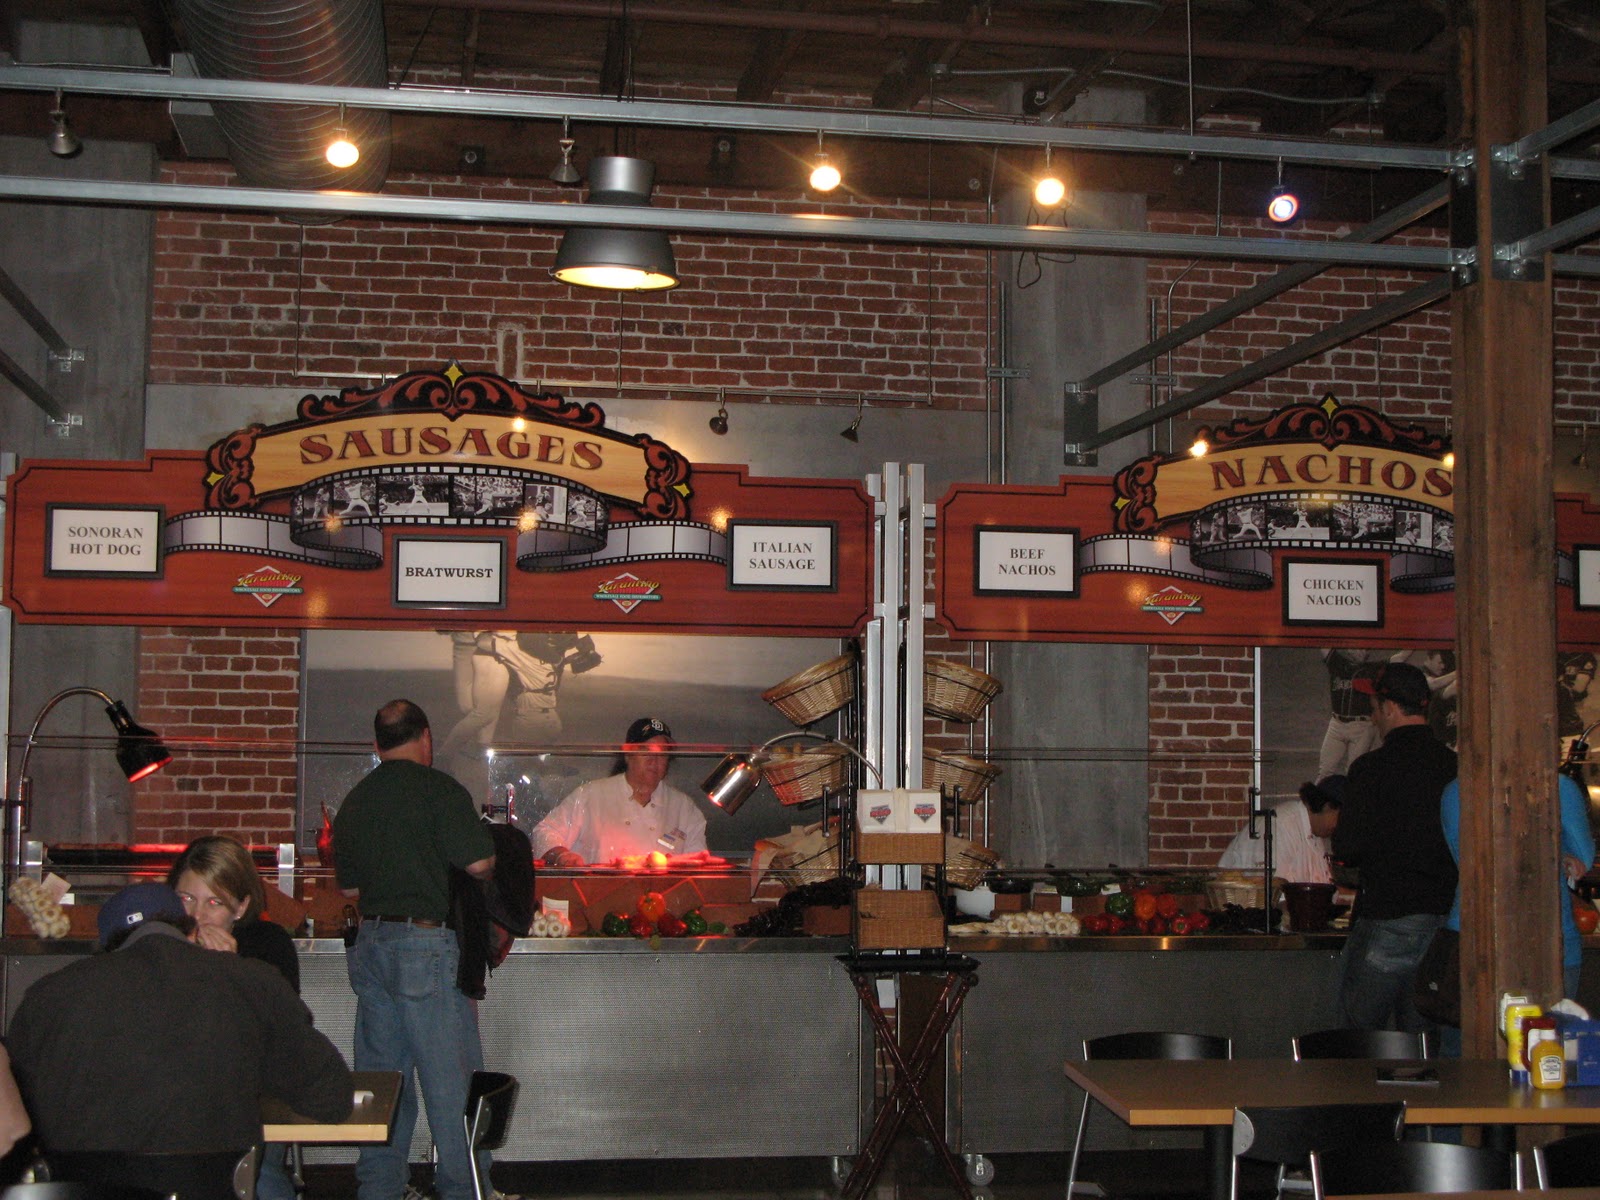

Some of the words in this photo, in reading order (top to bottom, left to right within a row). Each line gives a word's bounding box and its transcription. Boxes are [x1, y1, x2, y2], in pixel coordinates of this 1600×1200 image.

[300, 426, 603, 470] SAUSAGES
[1208, 454, 1454, 497] NACHOS
[68, 526, 144, 539] SONORAN
[69, 543, 103, 555] HOT
[107, 544, 142, 556] DOG
[752, 541, 813, 554] ITALIAN
[1010, 548, 1046, 560] BEEF
[749, 558, 816, 570] SAUSAGE
[998, 564, 1057, 576] NACHOS
[405, 567, 494, 578] BRATWURST
[1303, 579, 1365, 591] CHICKEN
[1306, 595, 1361, 606] NACHOS
